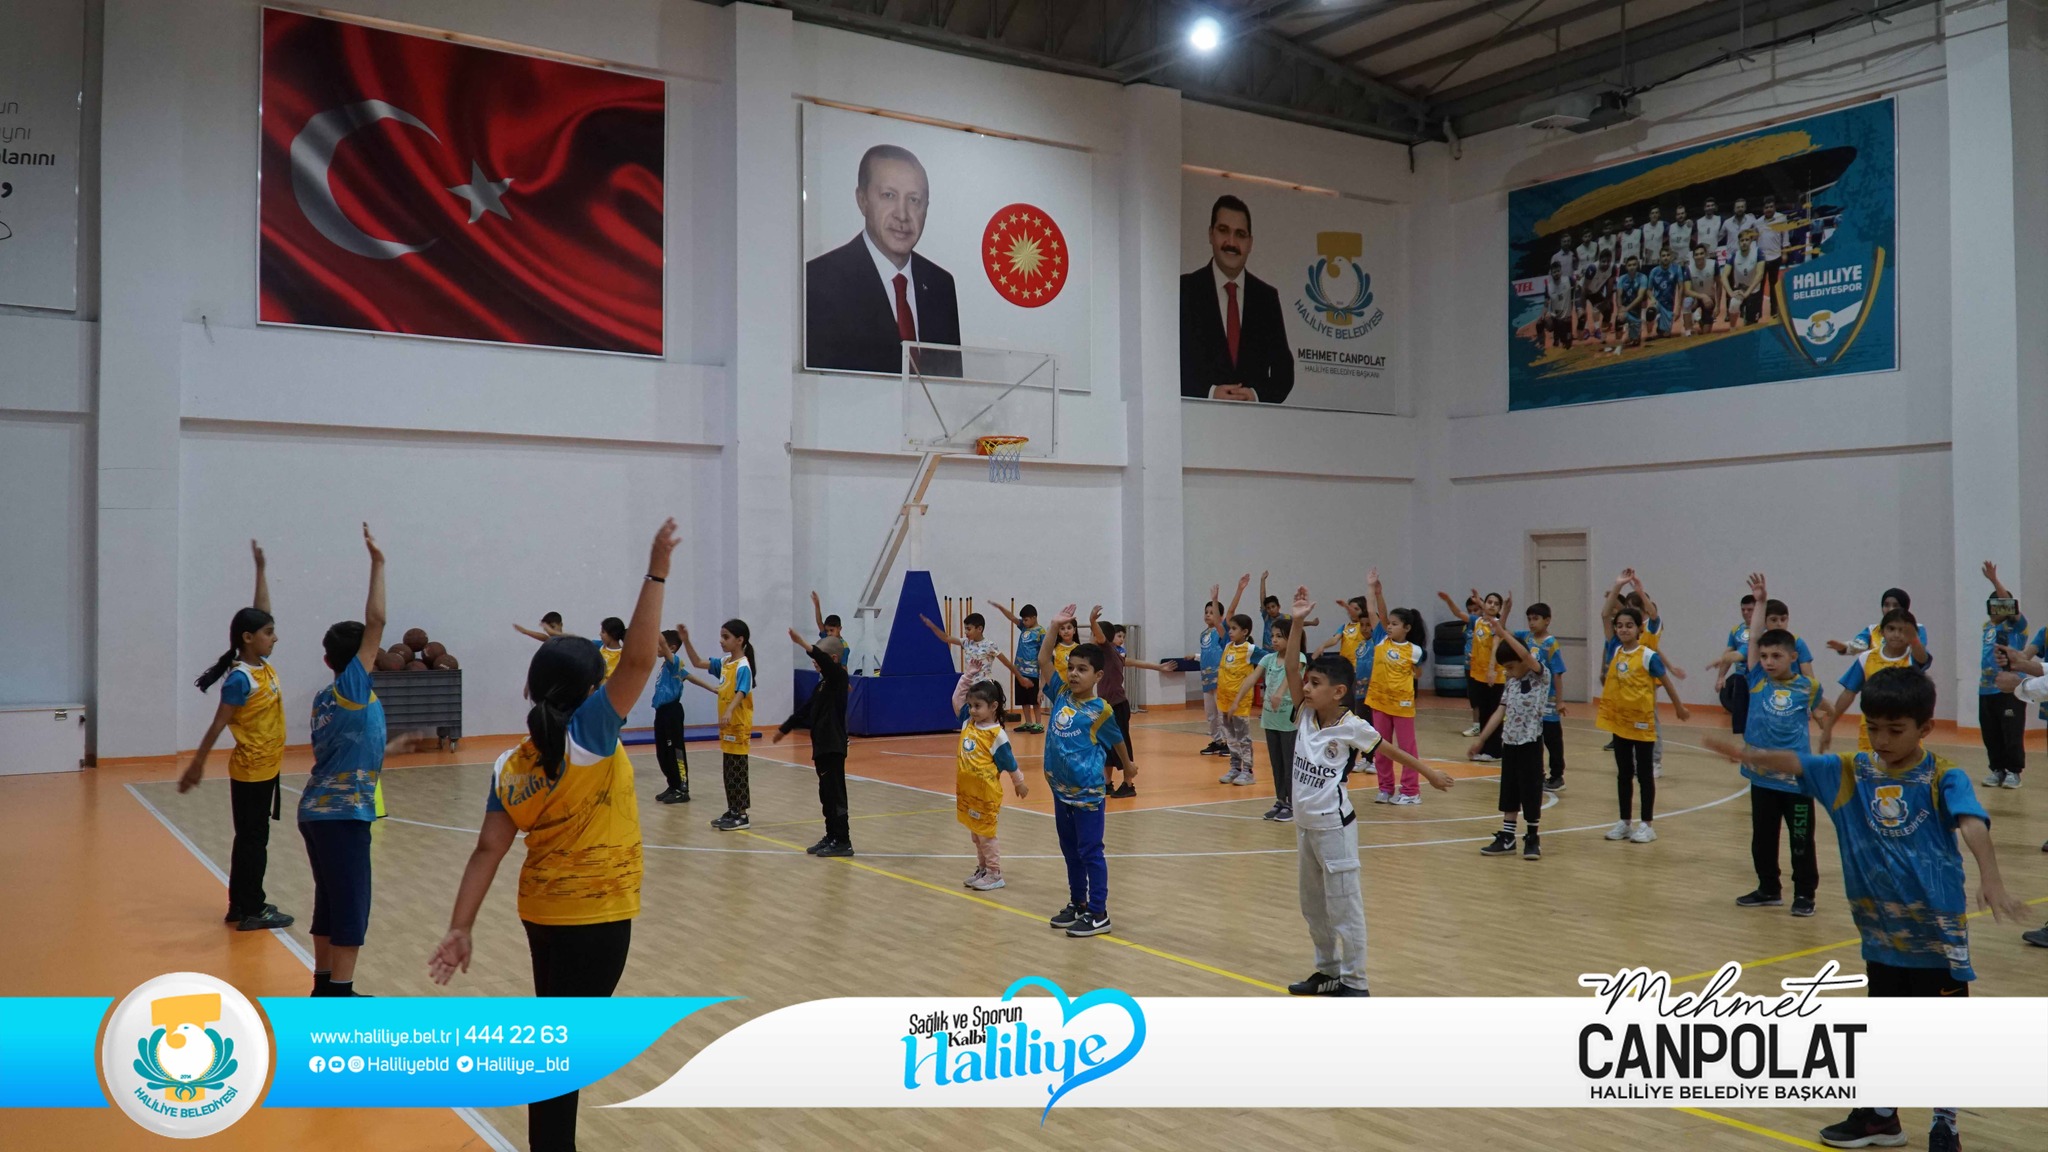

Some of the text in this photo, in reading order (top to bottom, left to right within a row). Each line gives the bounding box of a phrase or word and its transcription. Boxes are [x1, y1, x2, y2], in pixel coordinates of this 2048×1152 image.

[0, 127, 31, 143] ynı
[0, 149, 55, 166] lanını
[1295, 299, 1384, 339] HALİLİYE BELEDİYESİ
[1298, 348, 1386, 367] MEHMET CANPOLAT
[1299, 773, 1326, 789] BETTER
